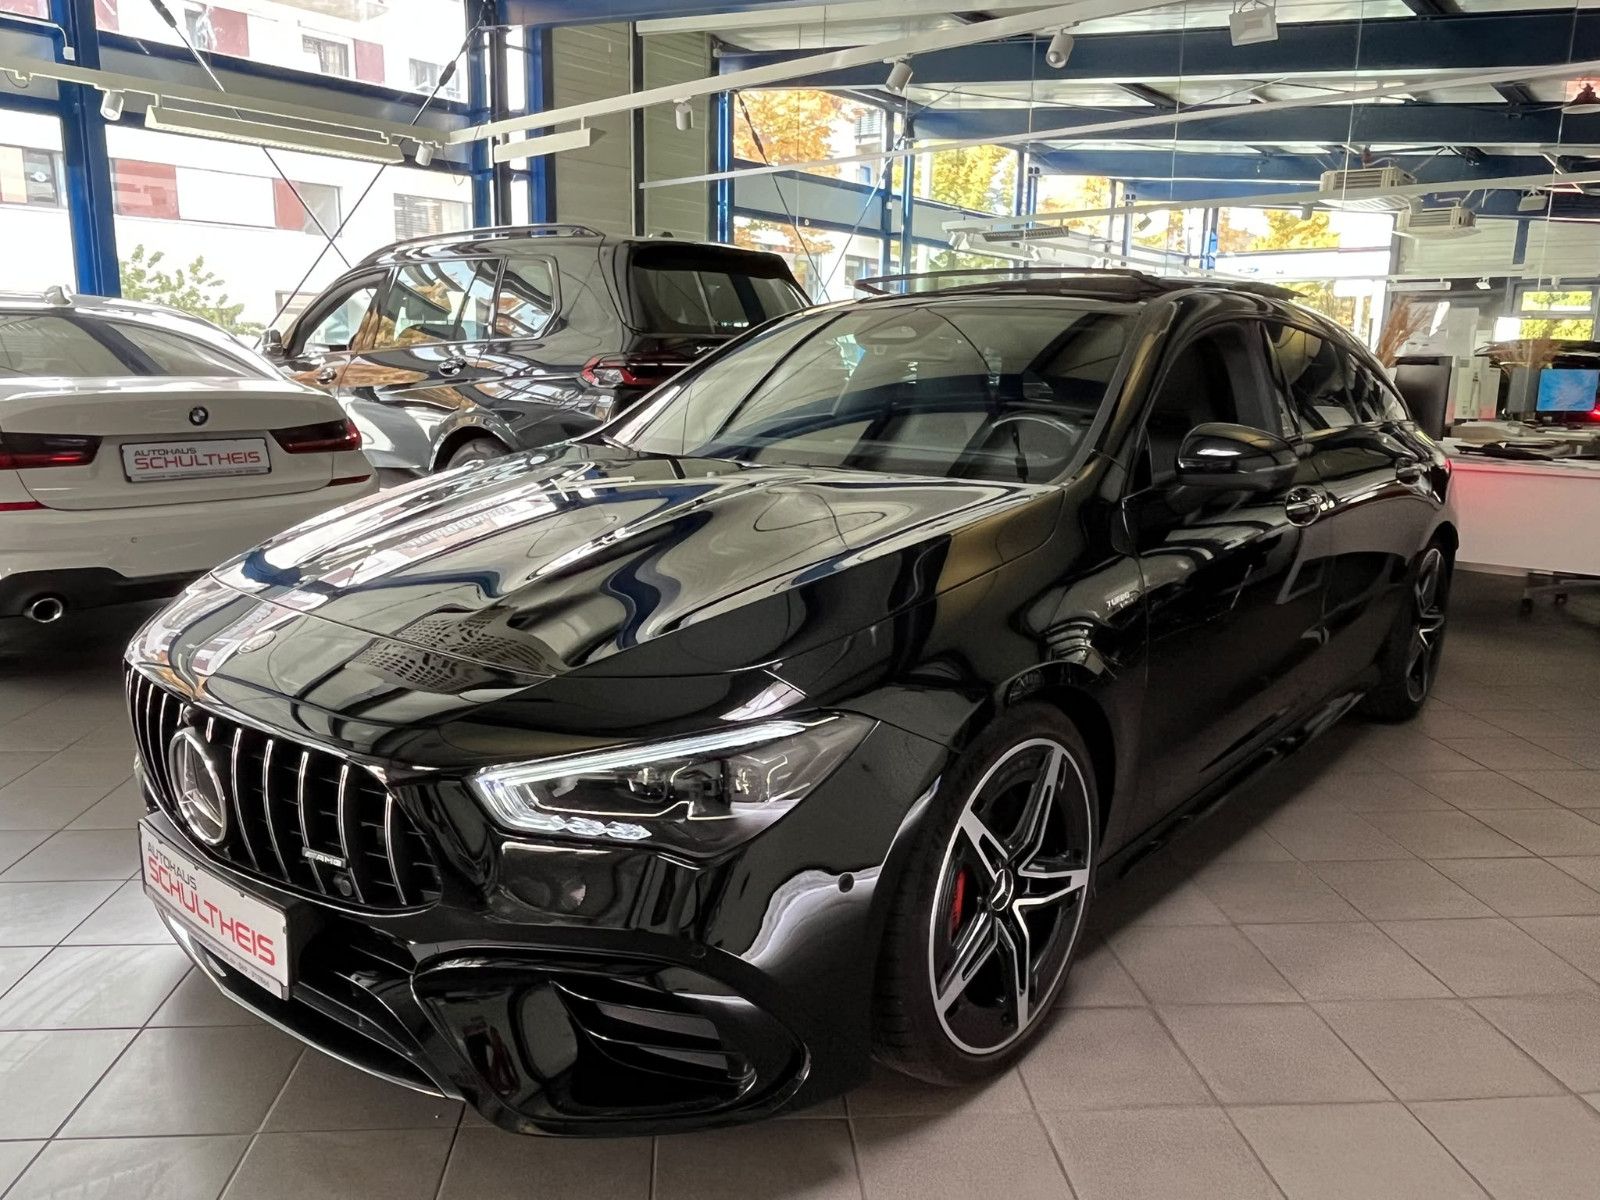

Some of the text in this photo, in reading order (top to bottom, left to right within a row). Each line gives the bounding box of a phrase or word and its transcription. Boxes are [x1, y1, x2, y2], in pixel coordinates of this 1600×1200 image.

[134, 447, 197, 457] AUTOHAUS
[134, 451, 261, 470] SCHULTHEIS
[148, 842, 197, 891] AUTOHAUS
[148, 856, 276, 966] SCHULTHEIS
